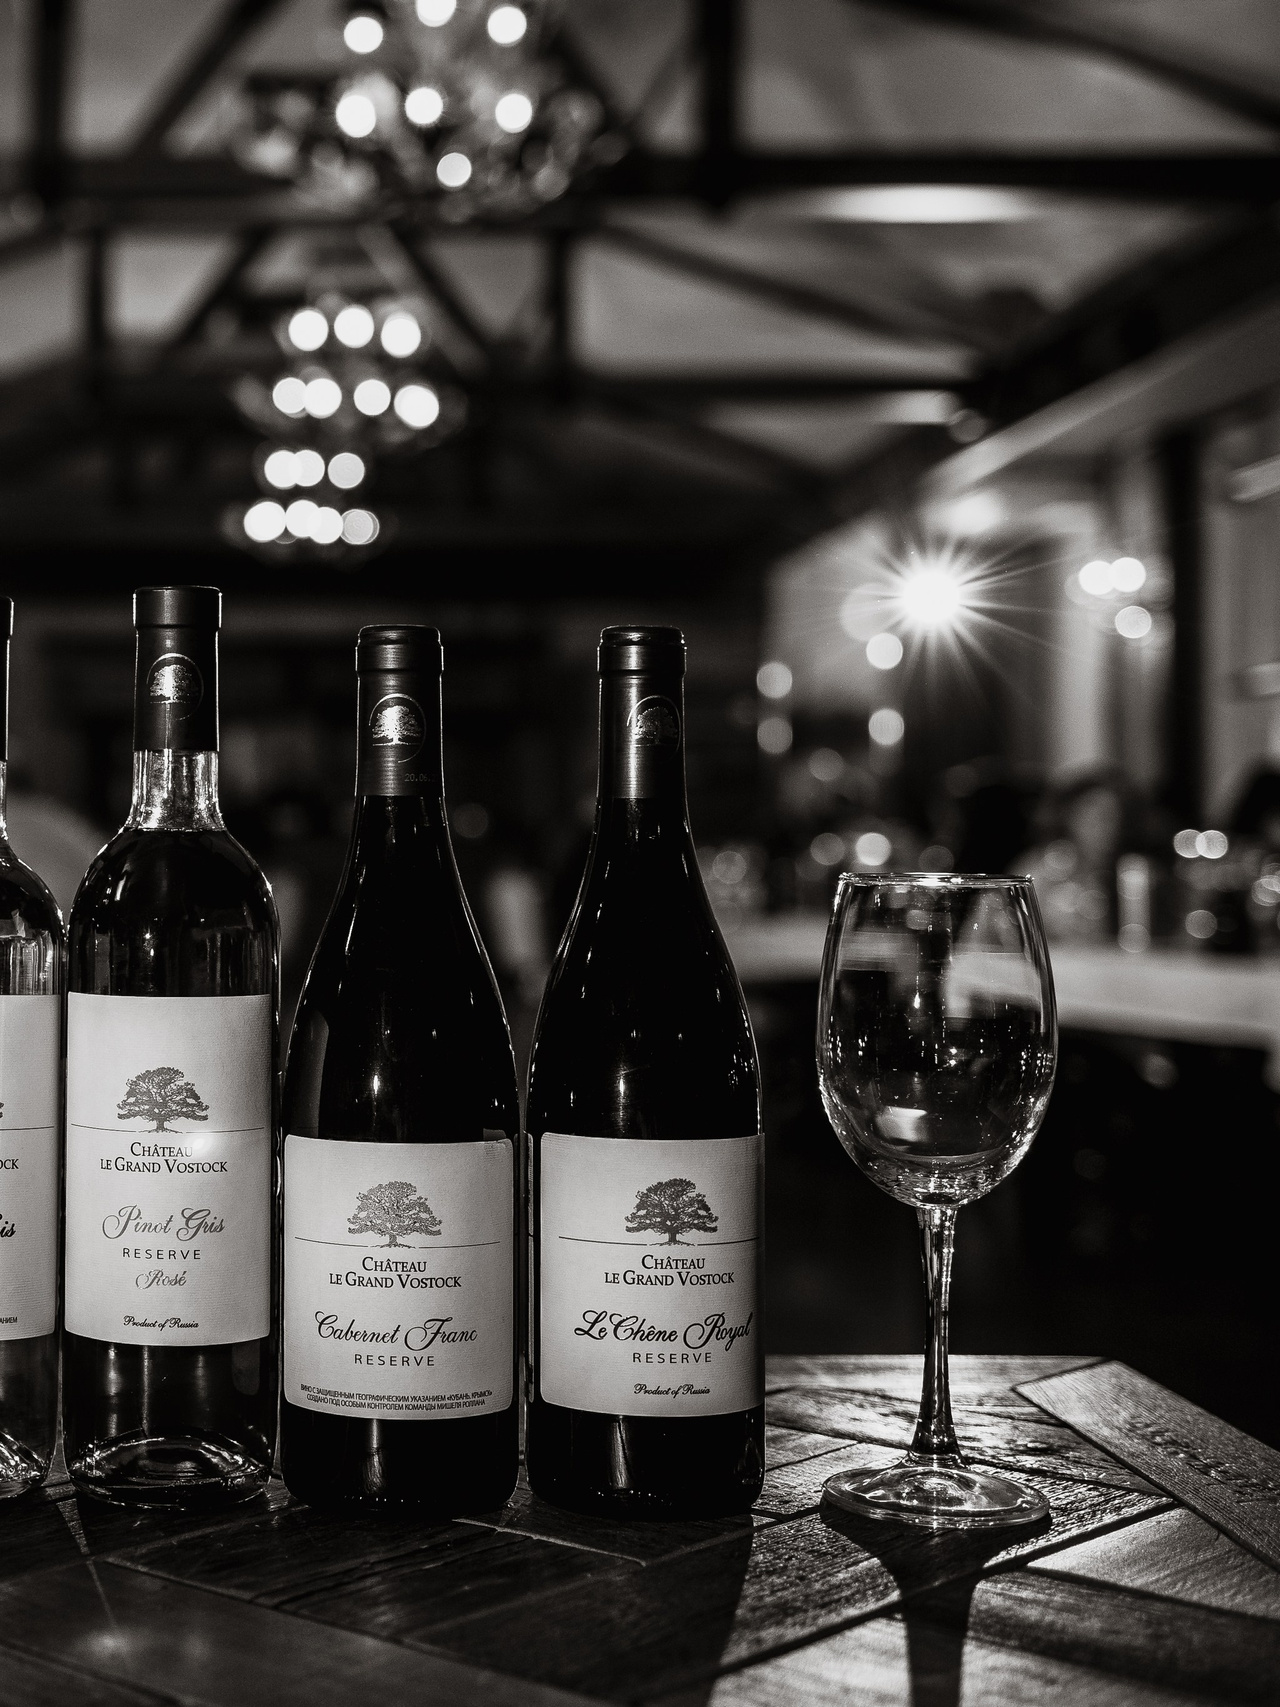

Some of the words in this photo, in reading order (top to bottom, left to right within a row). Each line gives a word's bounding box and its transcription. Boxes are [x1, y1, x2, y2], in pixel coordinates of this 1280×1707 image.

[130, 1142, 193, 1158] CHÂTEAU
[100, 1158, 112, 1170] LE
[114, 1157, 161, 1173] GRAND
[164, 1159, 228, 1173] VOSTOCK
[102, 1204, 174, 1240] Pinot
[176, 1208, 225, 1242] Gris
[122, 1248, 201, 1260] RESERVE
[641, 1254, 706, 1270] CHÂTEAU
[362, 1256, 427, 1272] CHÂTEAU
[136, 1269, 187, 1290] Rosé
[330, 1272, 342, 1285] LE
[345, 1272, 394, 1288] GRAND
[397, 1274, 462, 1288] VOSTOCK
[604, 1272, 620, 1284] LE
[622, 1270, 674, 1286] GRAND
[678, 1271, 734, 1286] VOSTOCK
[123, 1315, 158, 1328] Product
[158, 1319, 168, 1332] of
[169, 1317, 200, 1328] Russia
[314, 1310, 401, 1344] Cabernet
[404, 1316, 478, 1351] Franc
[574, 1310, 608, 1340] Le
[610, 1313, 678, 1342] Chêne
[683, 1312, 753, 1352] Royal
[354, 1354, 434, 1366] RESERVE
[632, 1352, 712, 1364] RESERVE
[634, 1383, 671, 1396] Product
[671, 1385, 682, 1398] of
[682, 1383, 710, 1395] Russia
